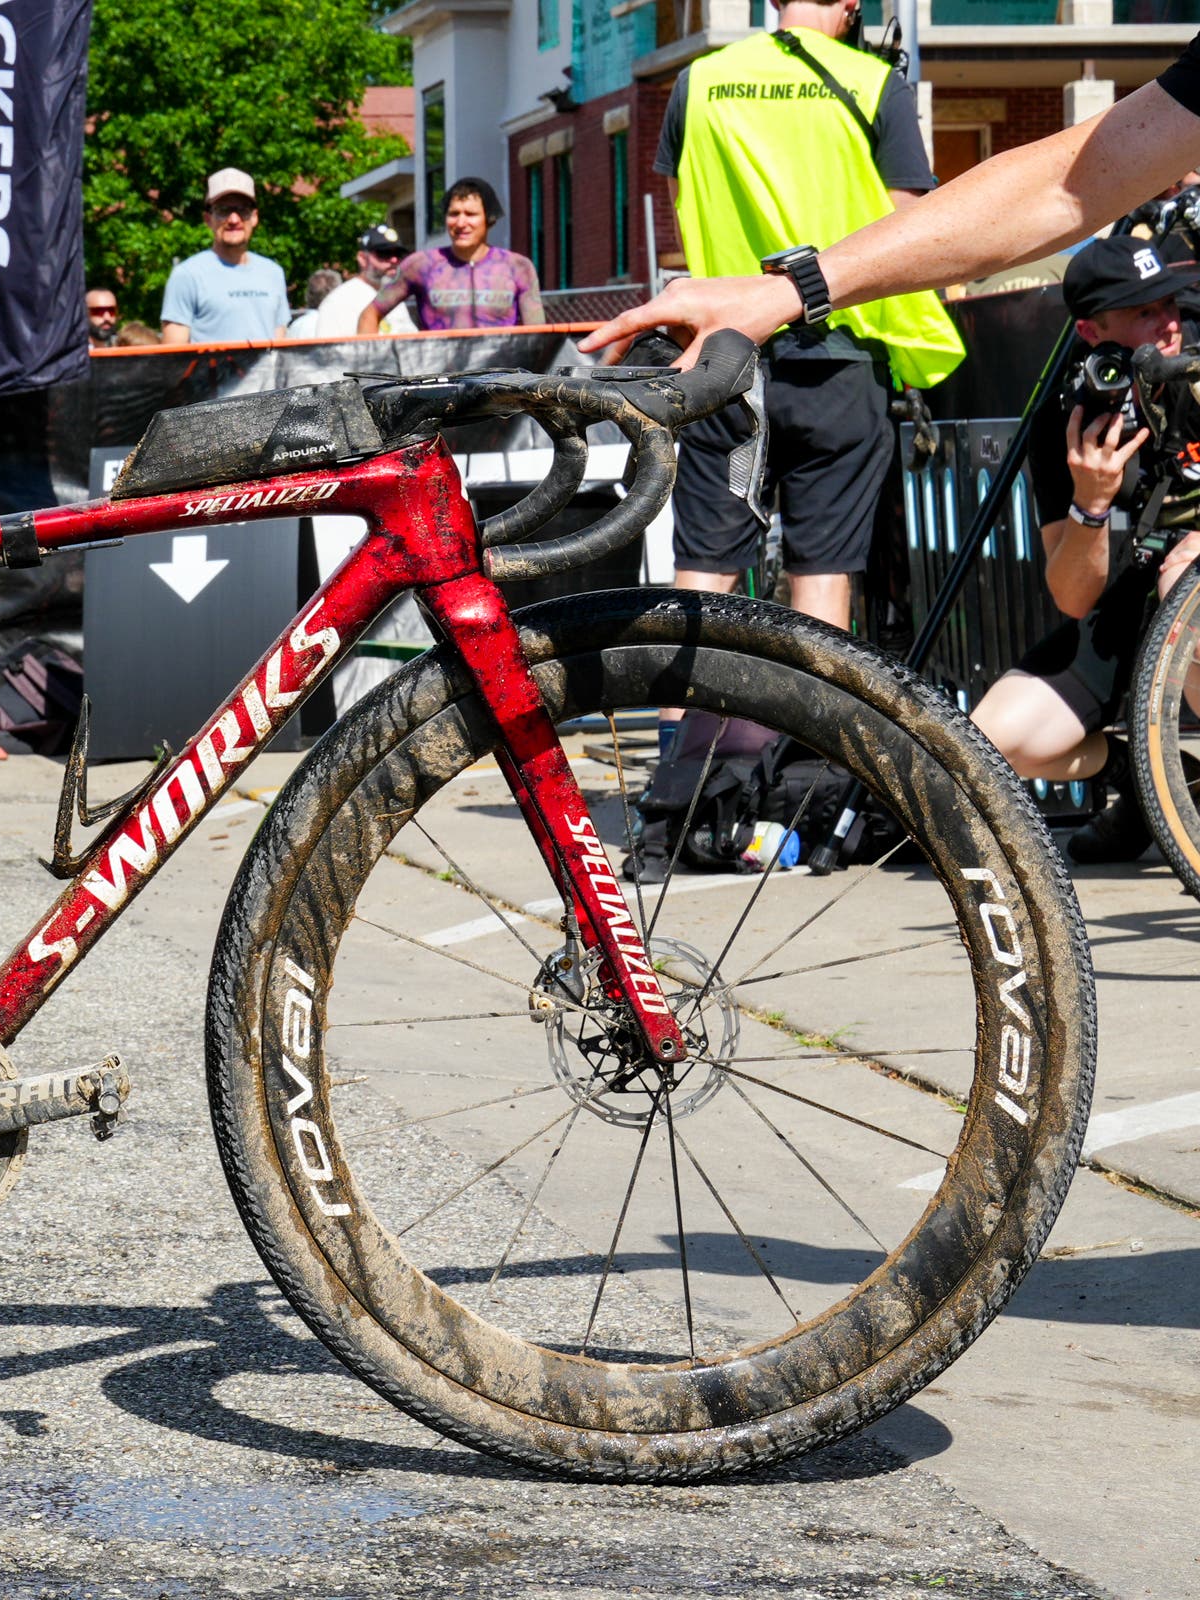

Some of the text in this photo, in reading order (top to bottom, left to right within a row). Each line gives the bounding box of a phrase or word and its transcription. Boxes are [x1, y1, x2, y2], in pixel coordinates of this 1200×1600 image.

[708, 83, 757, 101] FINISH
[760, 83, 794, 99] LINE
[273, 445, 328, 461] APIDURA
[179, 482, 340, 517] SPECIALIZED
[28, 597, 341, 993] S-WORKS
[564, 814, 669, 1014] SPECIALIZED
